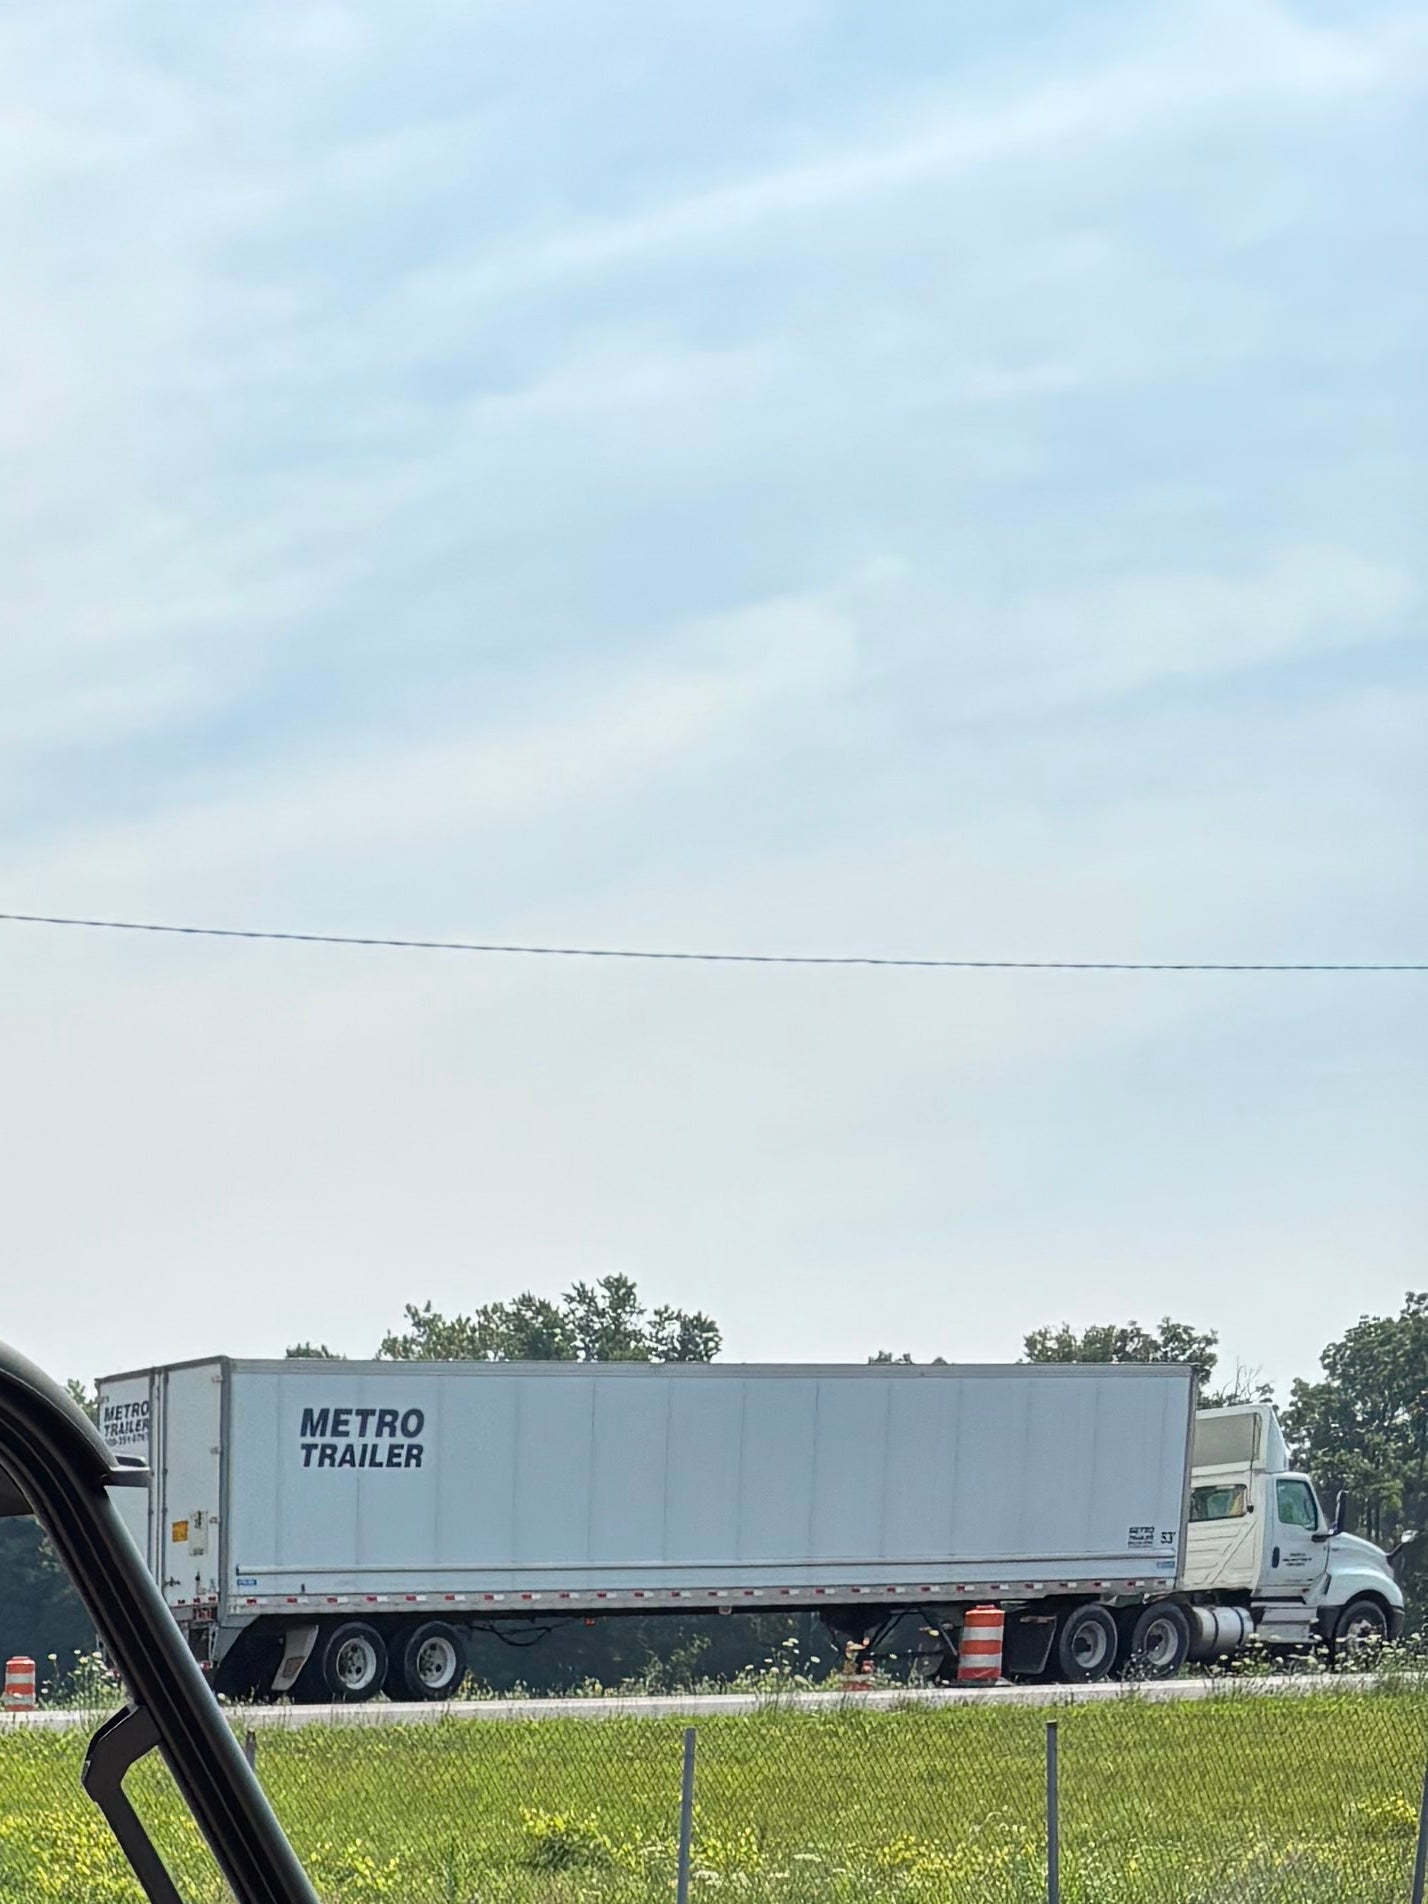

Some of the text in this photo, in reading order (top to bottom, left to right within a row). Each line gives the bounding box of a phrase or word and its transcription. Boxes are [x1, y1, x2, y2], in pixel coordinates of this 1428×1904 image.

[104, 1400, 149, 1422] METRO
[104, 1419, 149, 1437] TRAILER
[299, 1407, 425, 1439] METRO
[300, 1443, 424, 1468] TRAILER
